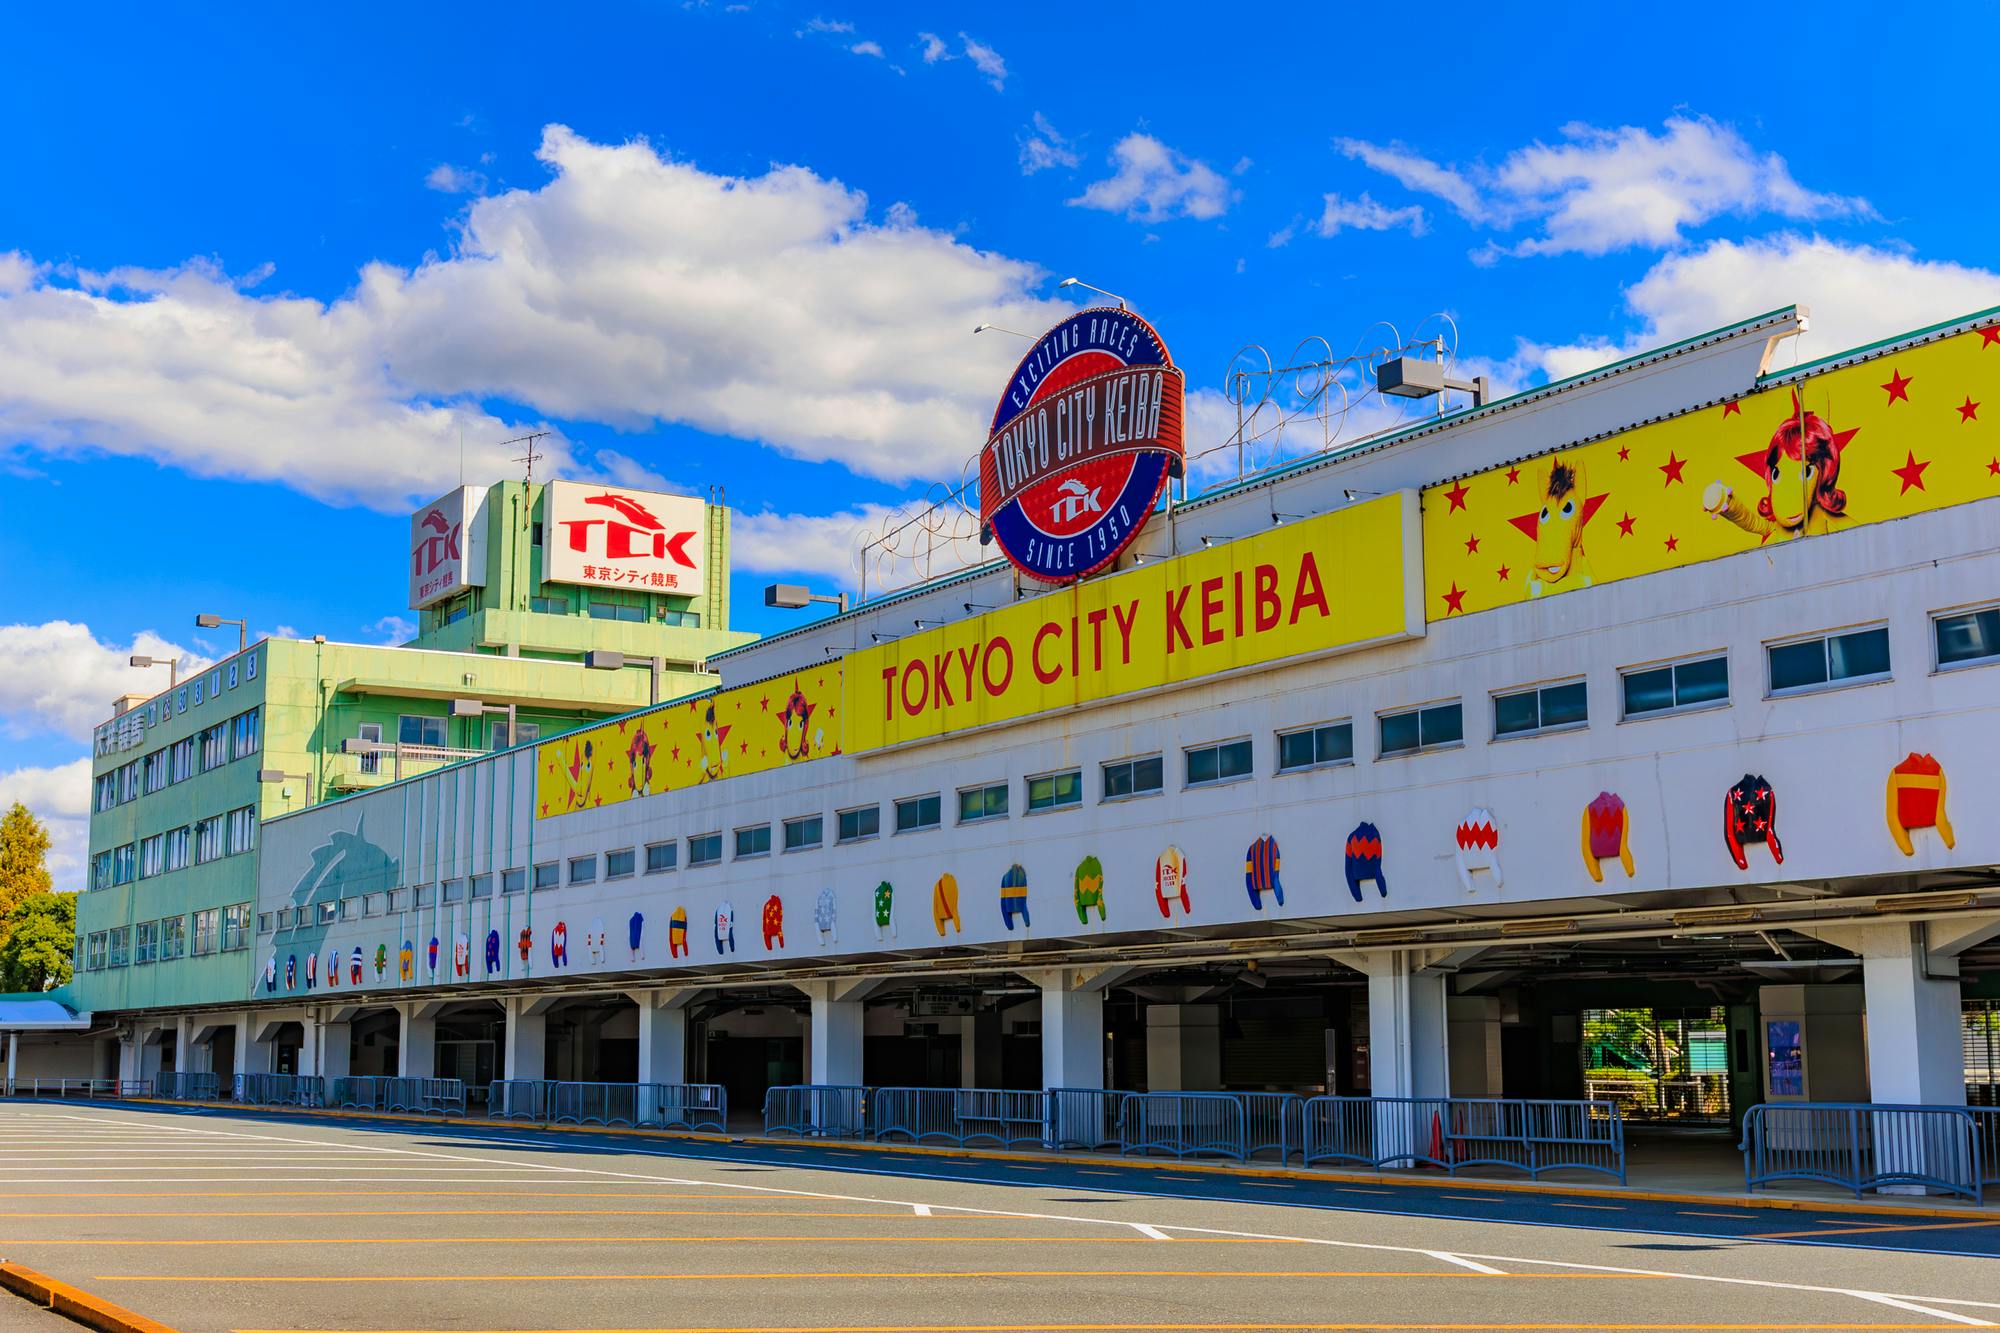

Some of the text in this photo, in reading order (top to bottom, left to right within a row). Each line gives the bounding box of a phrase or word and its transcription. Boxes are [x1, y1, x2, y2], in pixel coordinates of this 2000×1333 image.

[1012, 318, 1138, 408] EXCITING RACES
[991, 371, 1164, 498] TOKYO CITY KEIBA
[1049, 485, 1103, 524] TCK
[412, 521, 461, 577] TCK
[559, 519, 698, 570] TCK
[1026, 504, 1131, 570] SINCE 1950
[419, 571, 453, 599] 東京シティ競馬
[582, 564, 679, 589] 東京シティ競馬
[882, 551, 1330, 721] TOKYO CITY KEIBA
[230, 666, 237, 687] 2
[248, 654, 255, 677] 3
